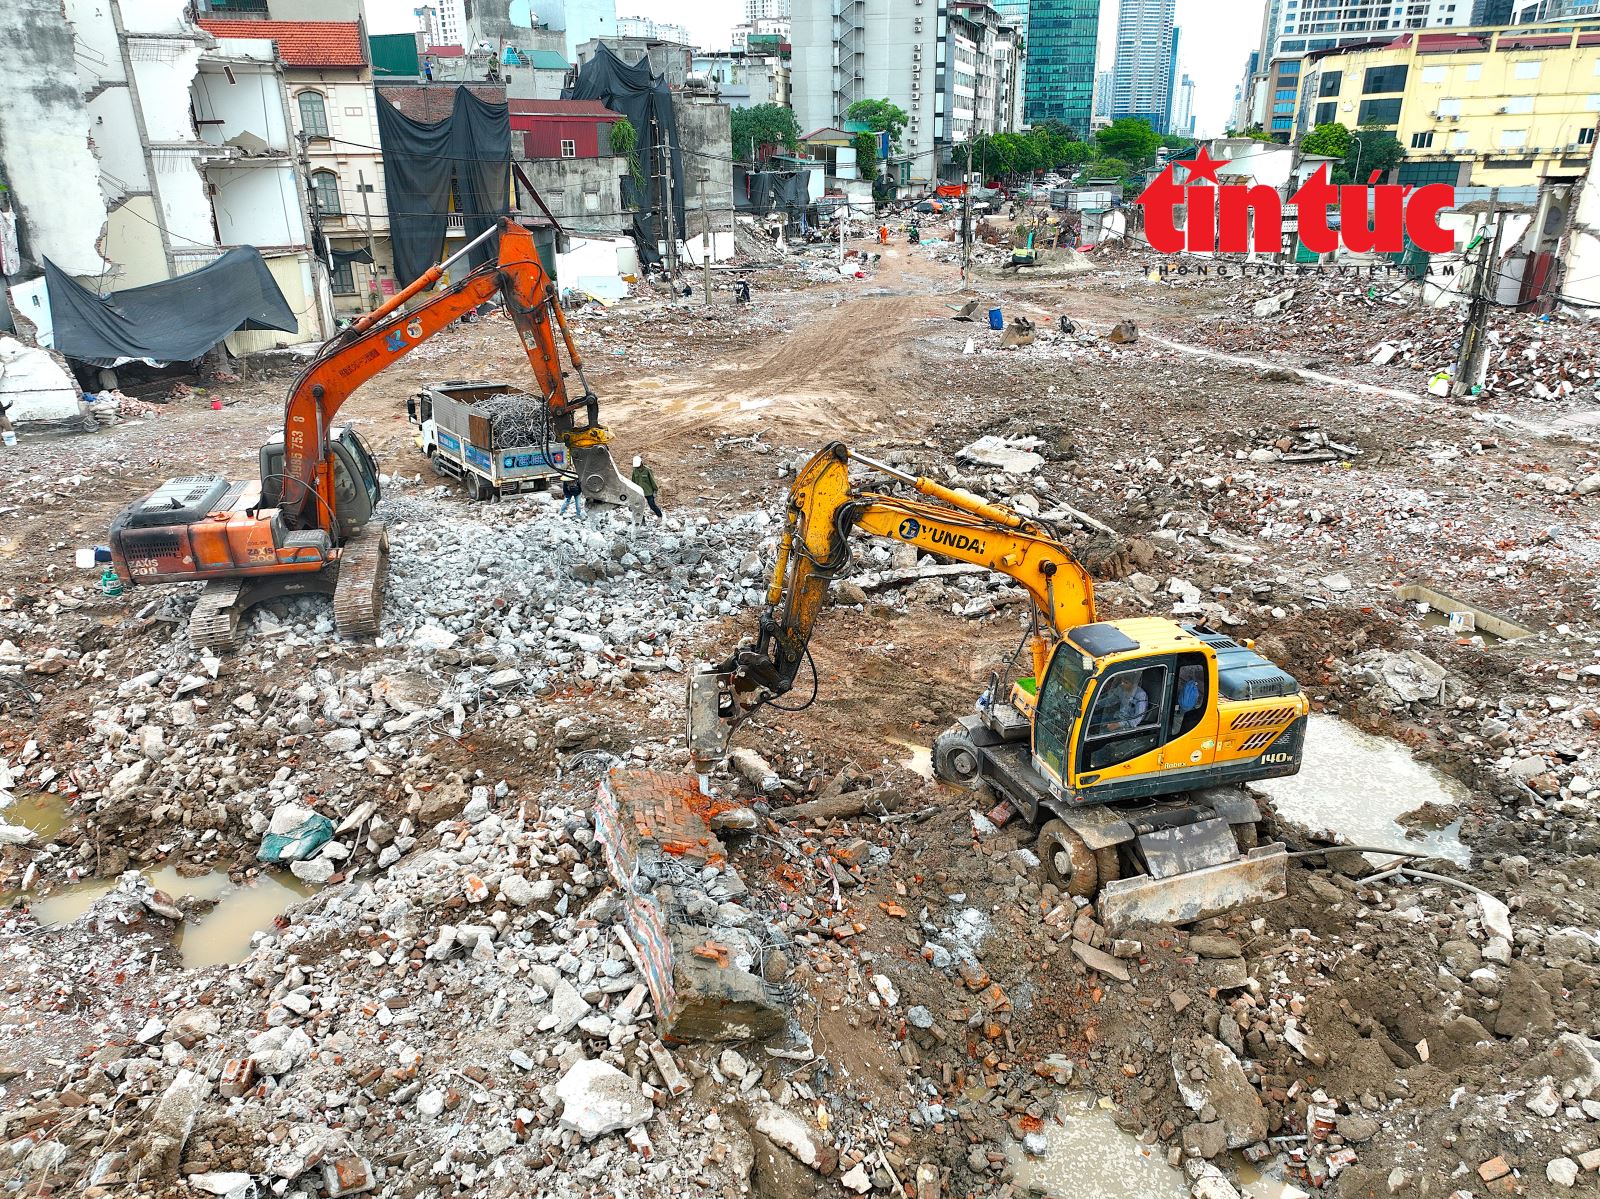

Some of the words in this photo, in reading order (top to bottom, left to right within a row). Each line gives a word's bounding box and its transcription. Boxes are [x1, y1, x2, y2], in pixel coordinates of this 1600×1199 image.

[291, 430, 304, 449] 753
[247, 546, 274, 556] ZAXIS
[128, 557, 159, 568] ZAXIS
[249, 554, 276, 562] 200
